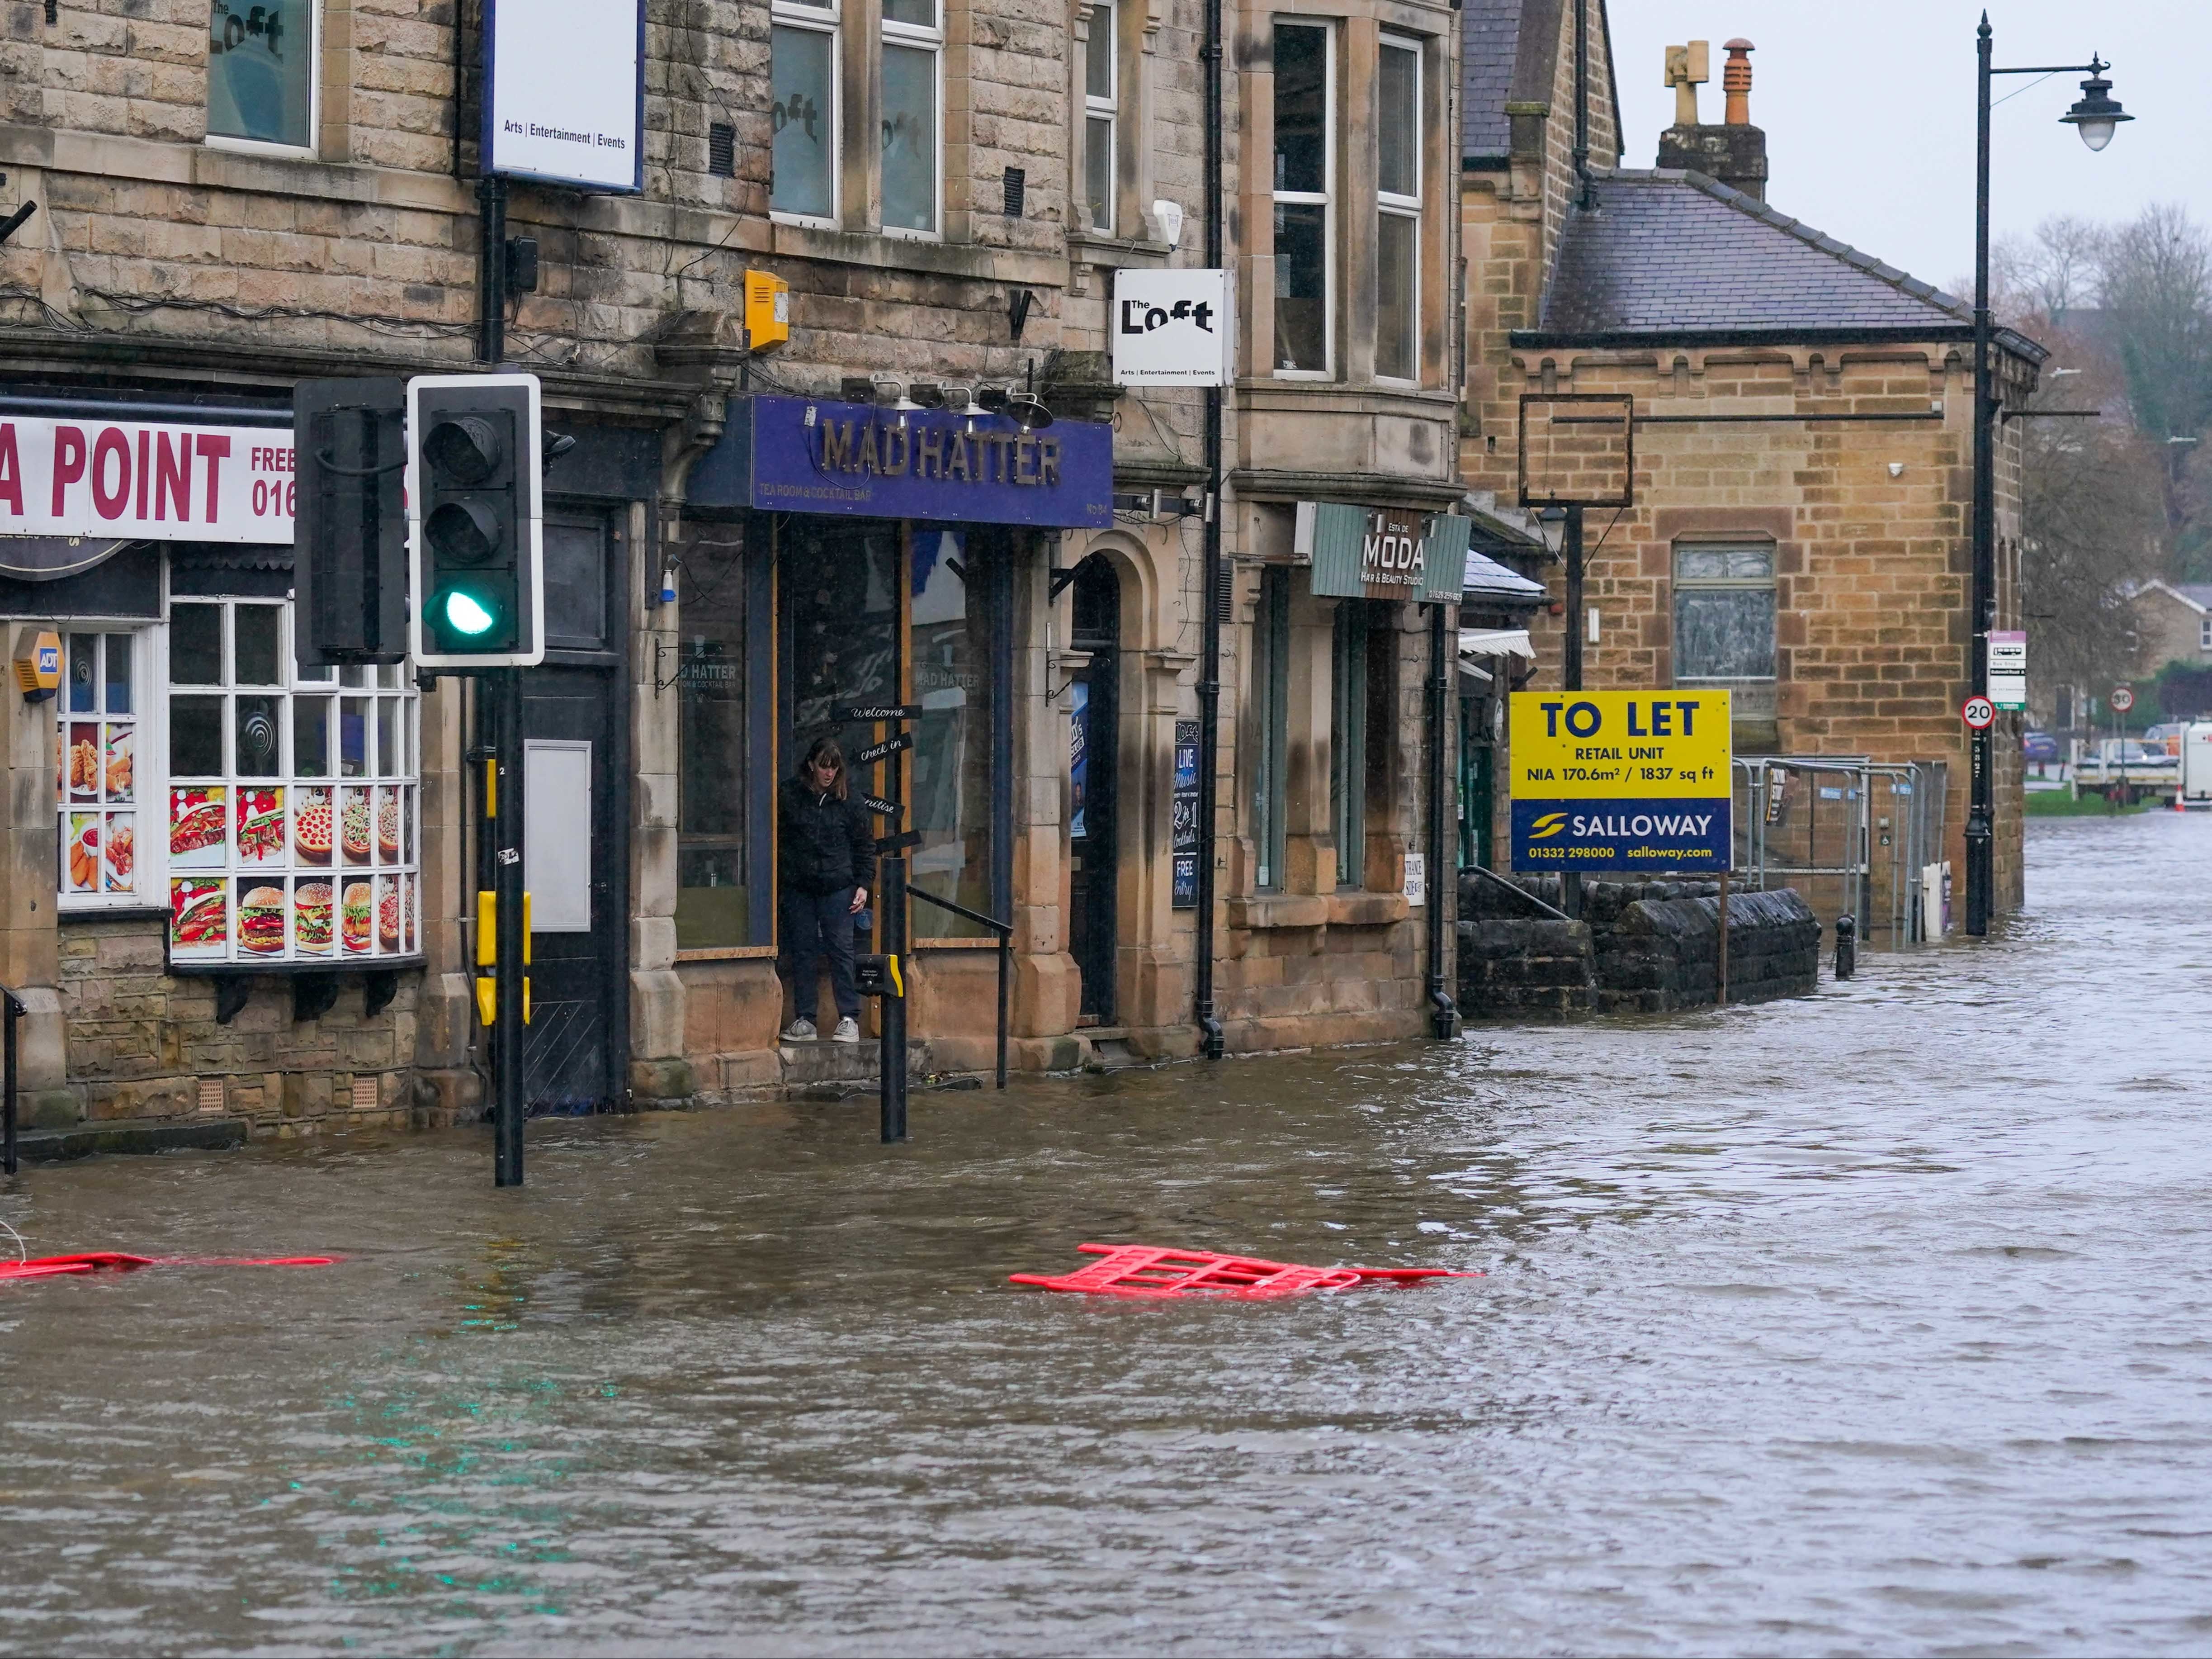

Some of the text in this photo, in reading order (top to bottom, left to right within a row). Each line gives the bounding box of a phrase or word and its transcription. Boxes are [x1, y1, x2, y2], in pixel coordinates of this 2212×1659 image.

[504, 119, 625, 149] Arts Entertainment Events
[1131, 300, 1150, 308] The
[1121, 300, 1213, 334] Loft
[823, 419, 1061, 485] MAD HATTER
[52, 426, 231, 523] POINT
[759, 483, 872, 501] TEA ROOM & COCKTAIL BAR
[1362, 534, 1424, 571] MODA
[1375, 573, 1380, 583] &
[40, 653, 58, 668] ADT
[692, 664, 737, 679] HATTER
[915, 672, 980, 687] MAD HATTER
[851, 707, 906, 718] Welcome
[1541, 702, 1700, 738] TO LET
[1967, 705, 1990, 719] 20
[890, 739, 902, 750] in
[1178, 749, 1194, 768] LIVE
[1575, 747, 1664, 760] RETAIL UNIT
[499, 767, 506, 775] 2
[1527, 768, 1555, 781] NIA
[1640, 767, 1673, 780] 1837
[1679, 770, 1696, 783] sq
[1702, 766, 1714, 779] ft
[1174, 801, 1182, 830] 2
[1191, 802, 1197, 828] 1
[1572, 815, 1712, 836] SALLOWAY
[1528, 846, 1712, 860] 01332 298000 salloway.com
[1177, 860, 1193, 877] FREE
